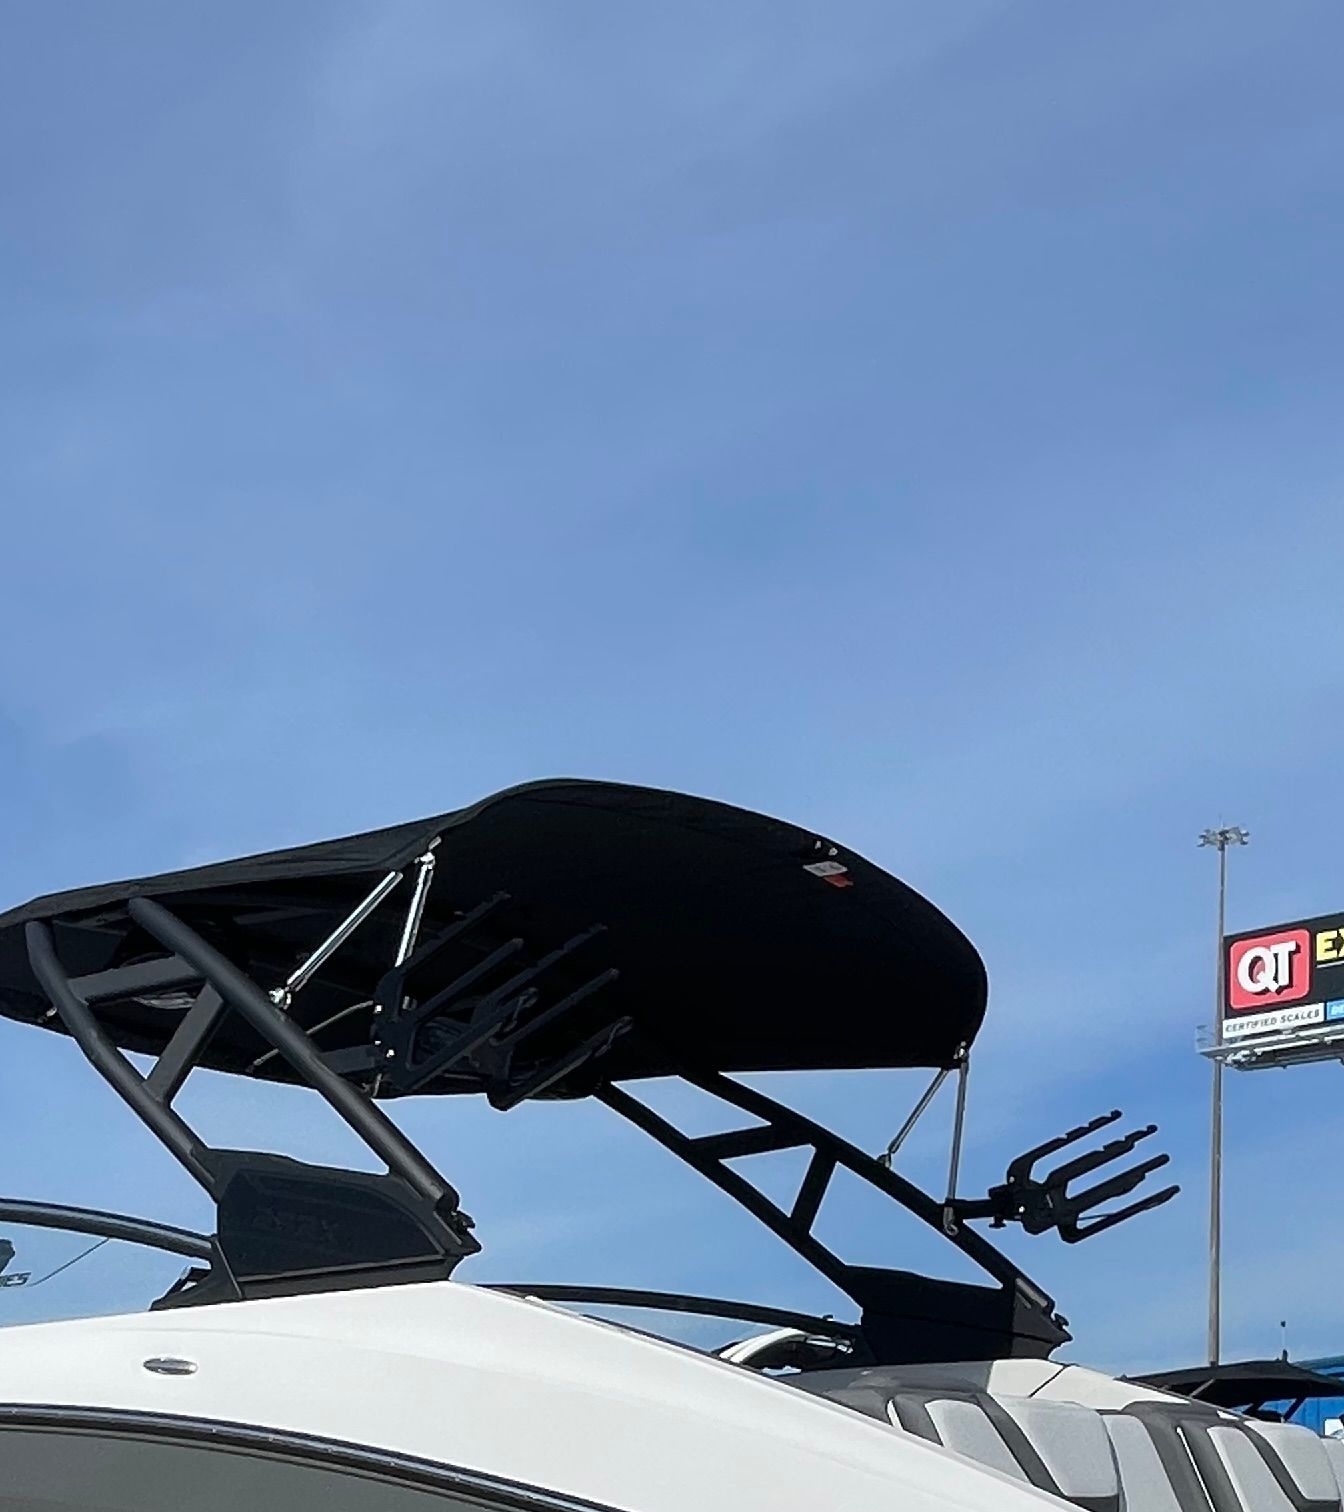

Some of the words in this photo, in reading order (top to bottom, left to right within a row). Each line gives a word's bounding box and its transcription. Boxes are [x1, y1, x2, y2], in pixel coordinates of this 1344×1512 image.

[1237, 940, 1298, 994] QT
[1225, 1017, 1277, 1033] CERTIFIED
[1280, 1009, 1320, 1024] SCALES
